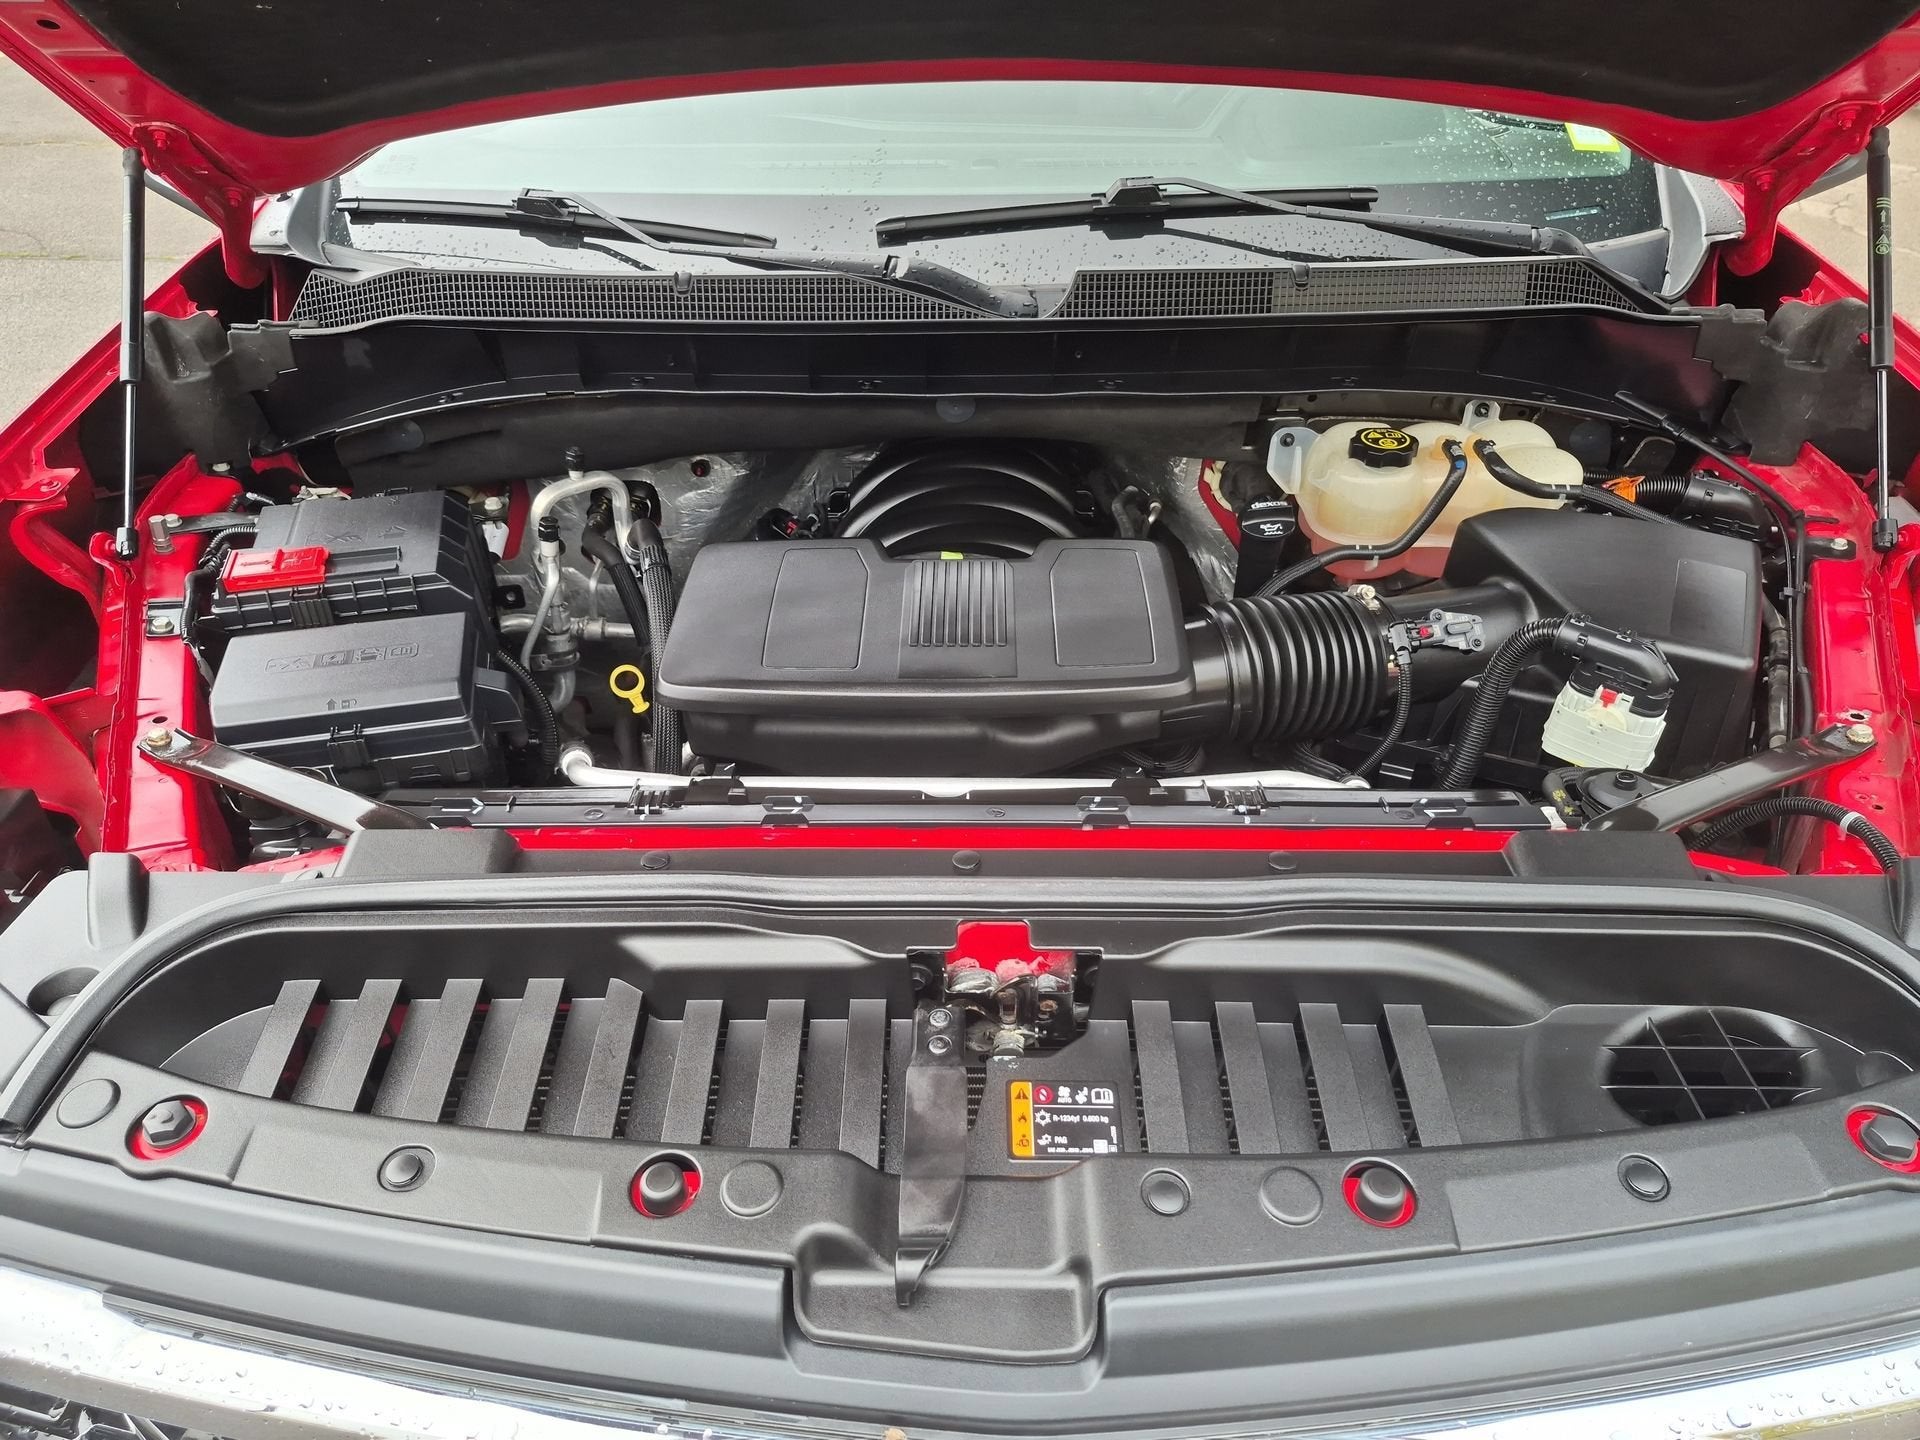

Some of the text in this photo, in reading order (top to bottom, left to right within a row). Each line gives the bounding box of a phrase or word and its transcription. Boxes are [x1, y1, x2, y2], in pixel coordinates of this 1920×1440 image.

[1251, 501, 1288, 509] dexos
[1053, 1114, 1080, 1123] R-1234yf
[1101, 1115, 1109, 1123] kg
[1054, 1136, 1068, 1144] PAG
